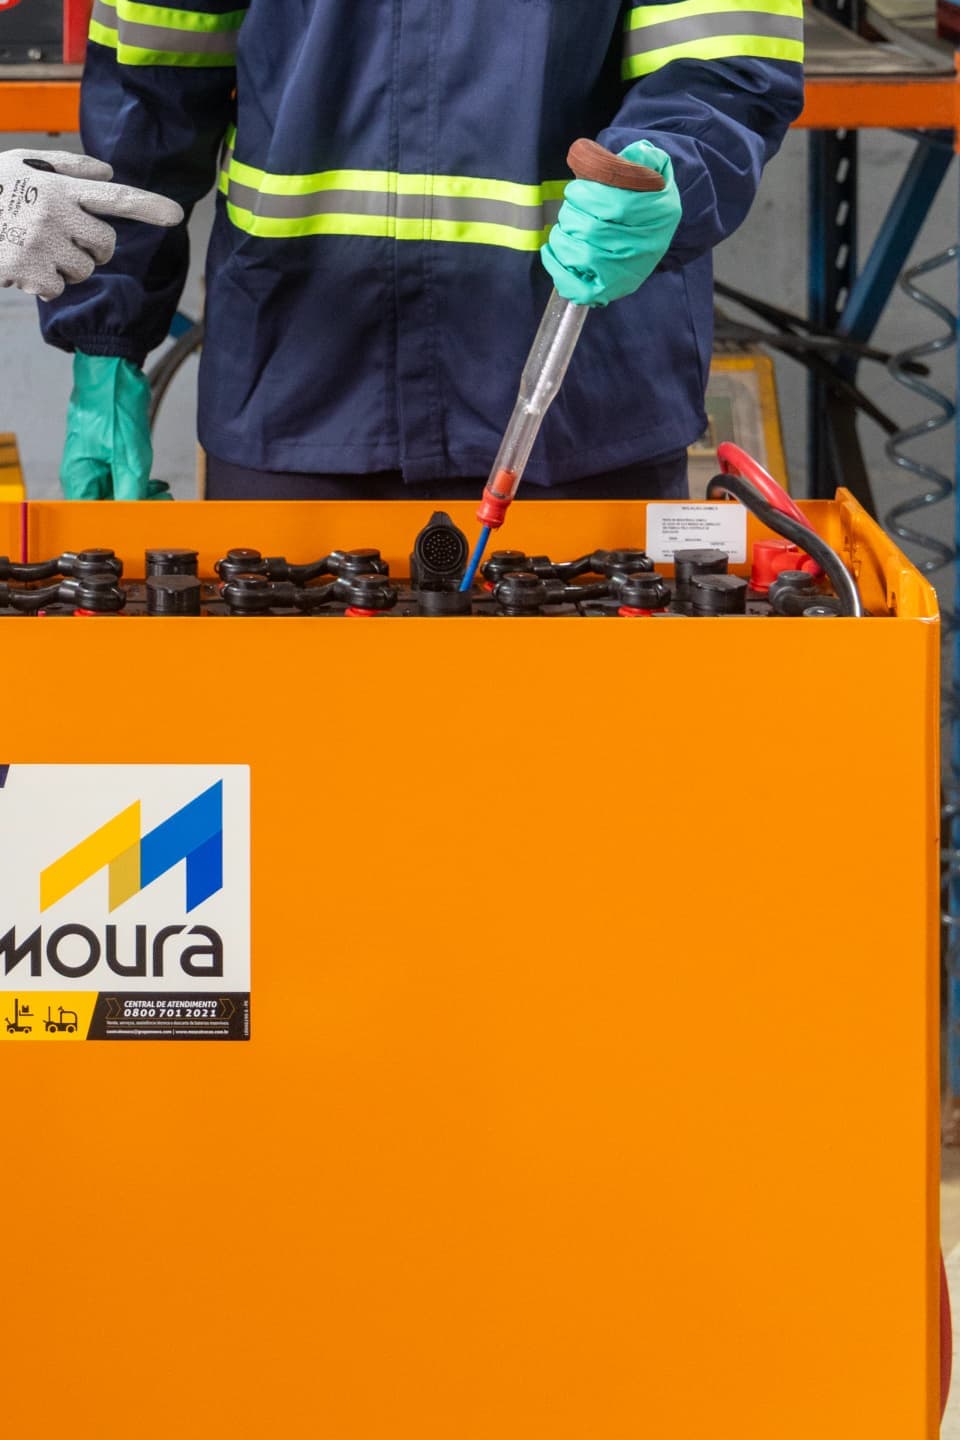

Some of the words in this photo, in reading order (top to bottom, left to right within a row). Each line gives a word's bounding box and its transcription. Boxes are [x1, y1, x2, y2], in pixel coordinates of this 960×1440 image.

[123, 1000, 156, 1009] CENTRAL
[156, 1000, 167, 1009] DE
[167, 1000, 218, 1009] ATENDIMENTO
[124, 1009, 156, 1017] 0800
[160, 1009, 182, 1017] 701
[186, 1009, 217, 1017] 2021
